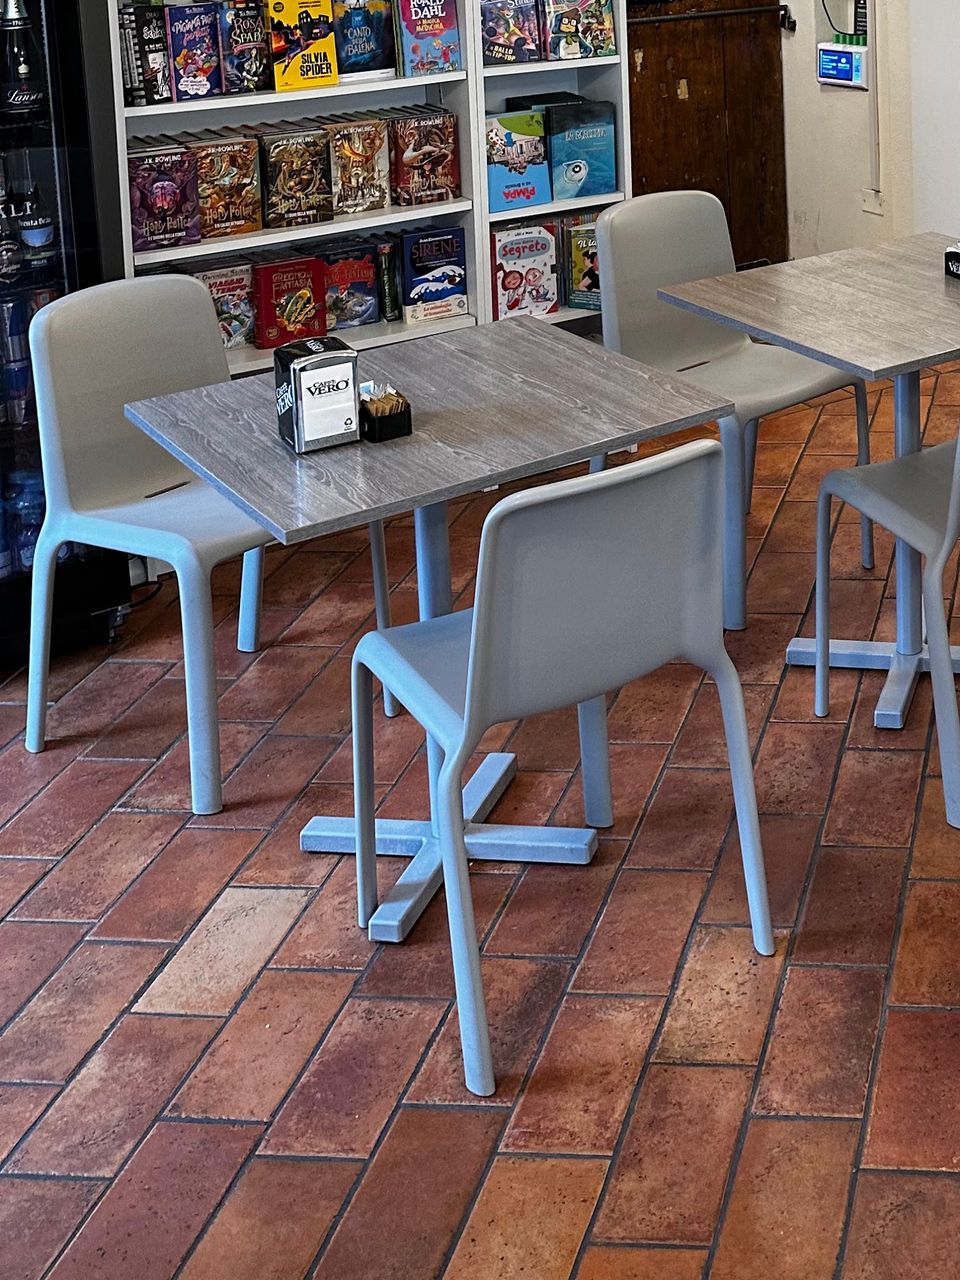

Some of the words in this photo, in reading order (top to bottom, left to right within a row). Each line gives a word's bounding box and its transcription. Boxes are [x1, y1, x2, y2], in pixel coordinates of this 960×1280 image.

[411, 7, 446, 20] DAHL
[233, 17, 262, 31] ROSA
[231, 28, 266, 46] SPADA
[347, 26, 371, 38] CANTO
[347, 43, 376, 56] BALENA
[494, 46, 513, 55] BALLO
[301, 52, 328, 64] SILVIA
[299, 62, 333, 77] SPIDER
[7, 90, 43, 104] Lanson
[155, 155, 181, 163] ROWLING
[503, 187, 536, 200] PIMPA
[206, 207, 229, 222] Harry
[229, 205, 253, 218] Potter
[142, 219, 166, 237] Harry
[166, 216, 191, 231] Potter
[411, 239, 461, 259] SIRENE
[502, 241, 547, 258] Segreto
[208, 277, 244, 290] VIAGGIO
[306, 379, 349, 397] VERO
[313, 379, 336, 388] CAFFÈ
